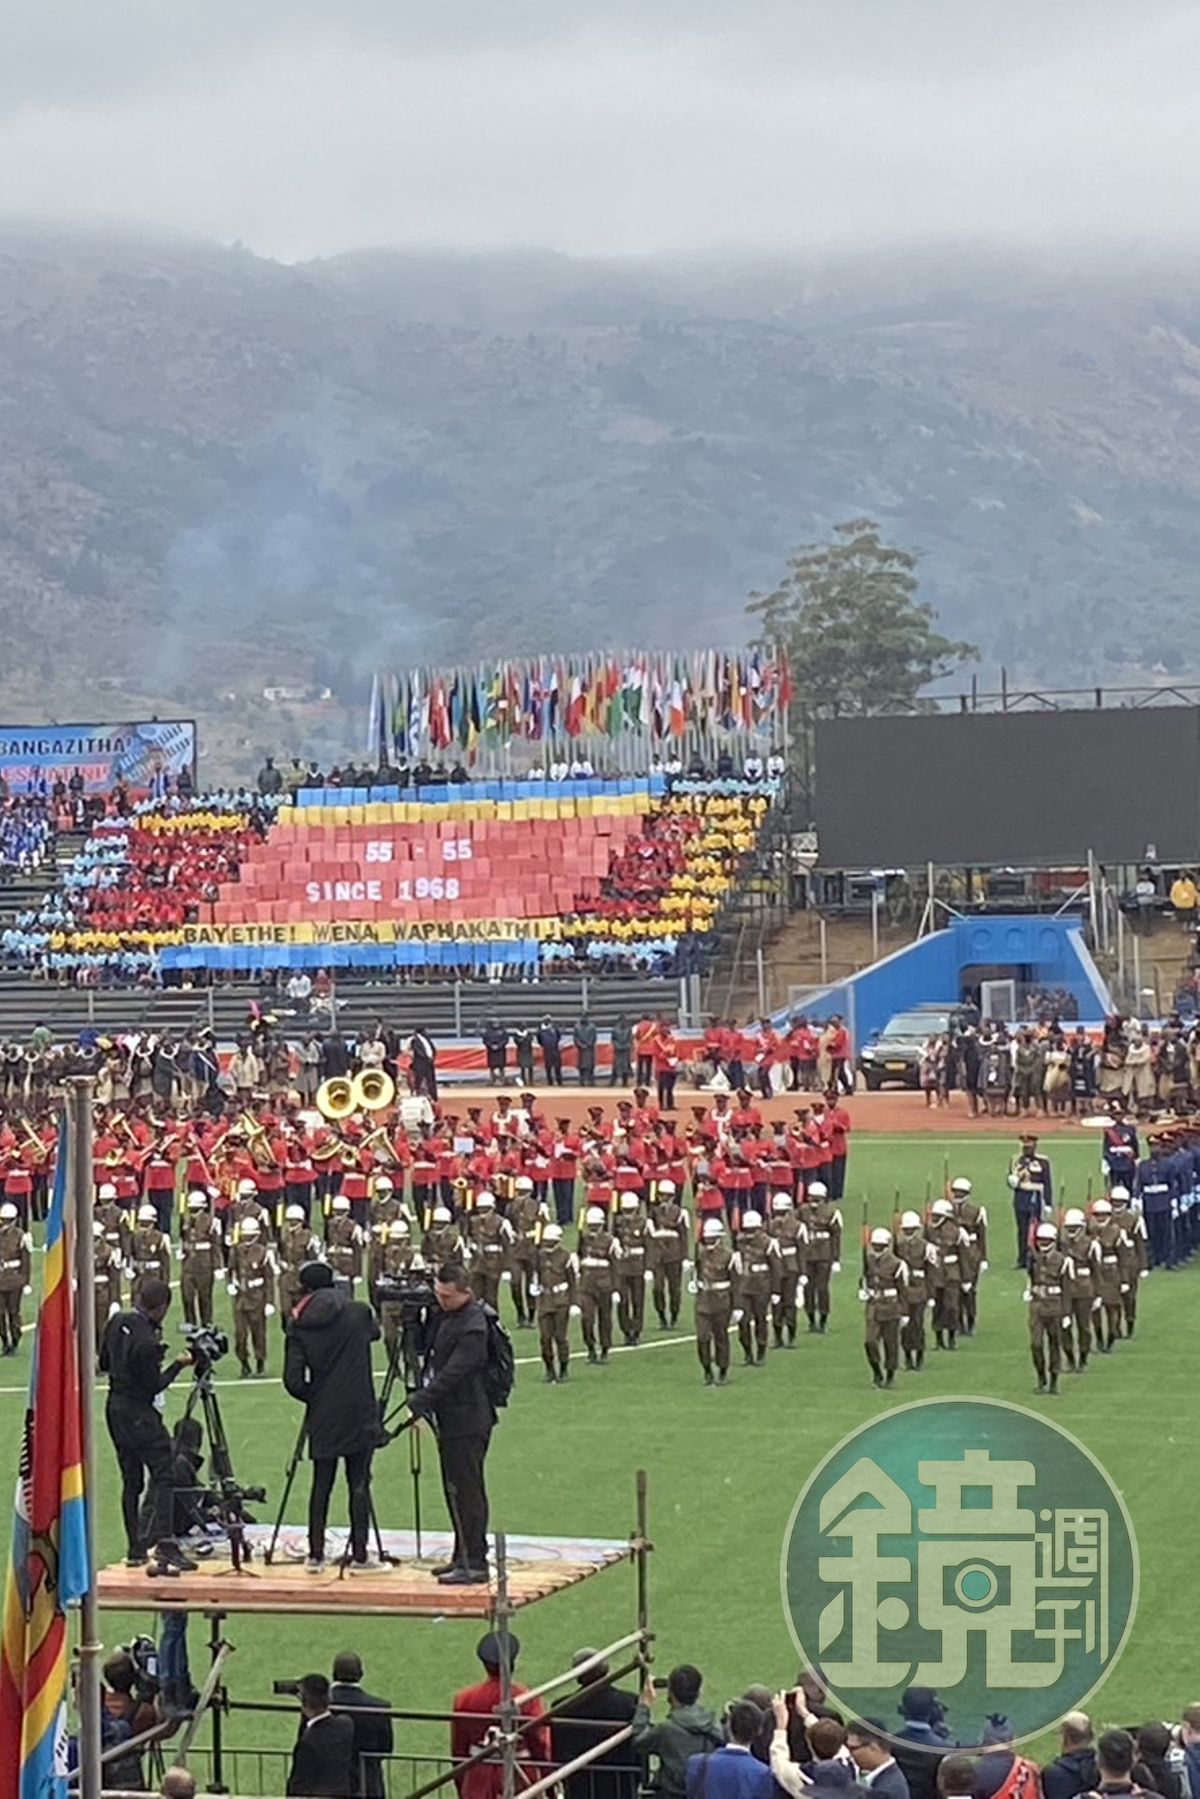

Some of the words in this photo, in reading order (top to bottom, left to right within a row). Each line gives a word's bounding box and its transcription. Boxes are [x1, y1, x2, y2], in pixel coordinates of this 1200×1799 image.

[365, 841, 393, 862] 55
[442, 839, 472, 861] 55
[306, 880, 382, 902] SINCE
[398, 878, 460, 901] 1968
[184, 925, 296, 943] BAYETHE!
